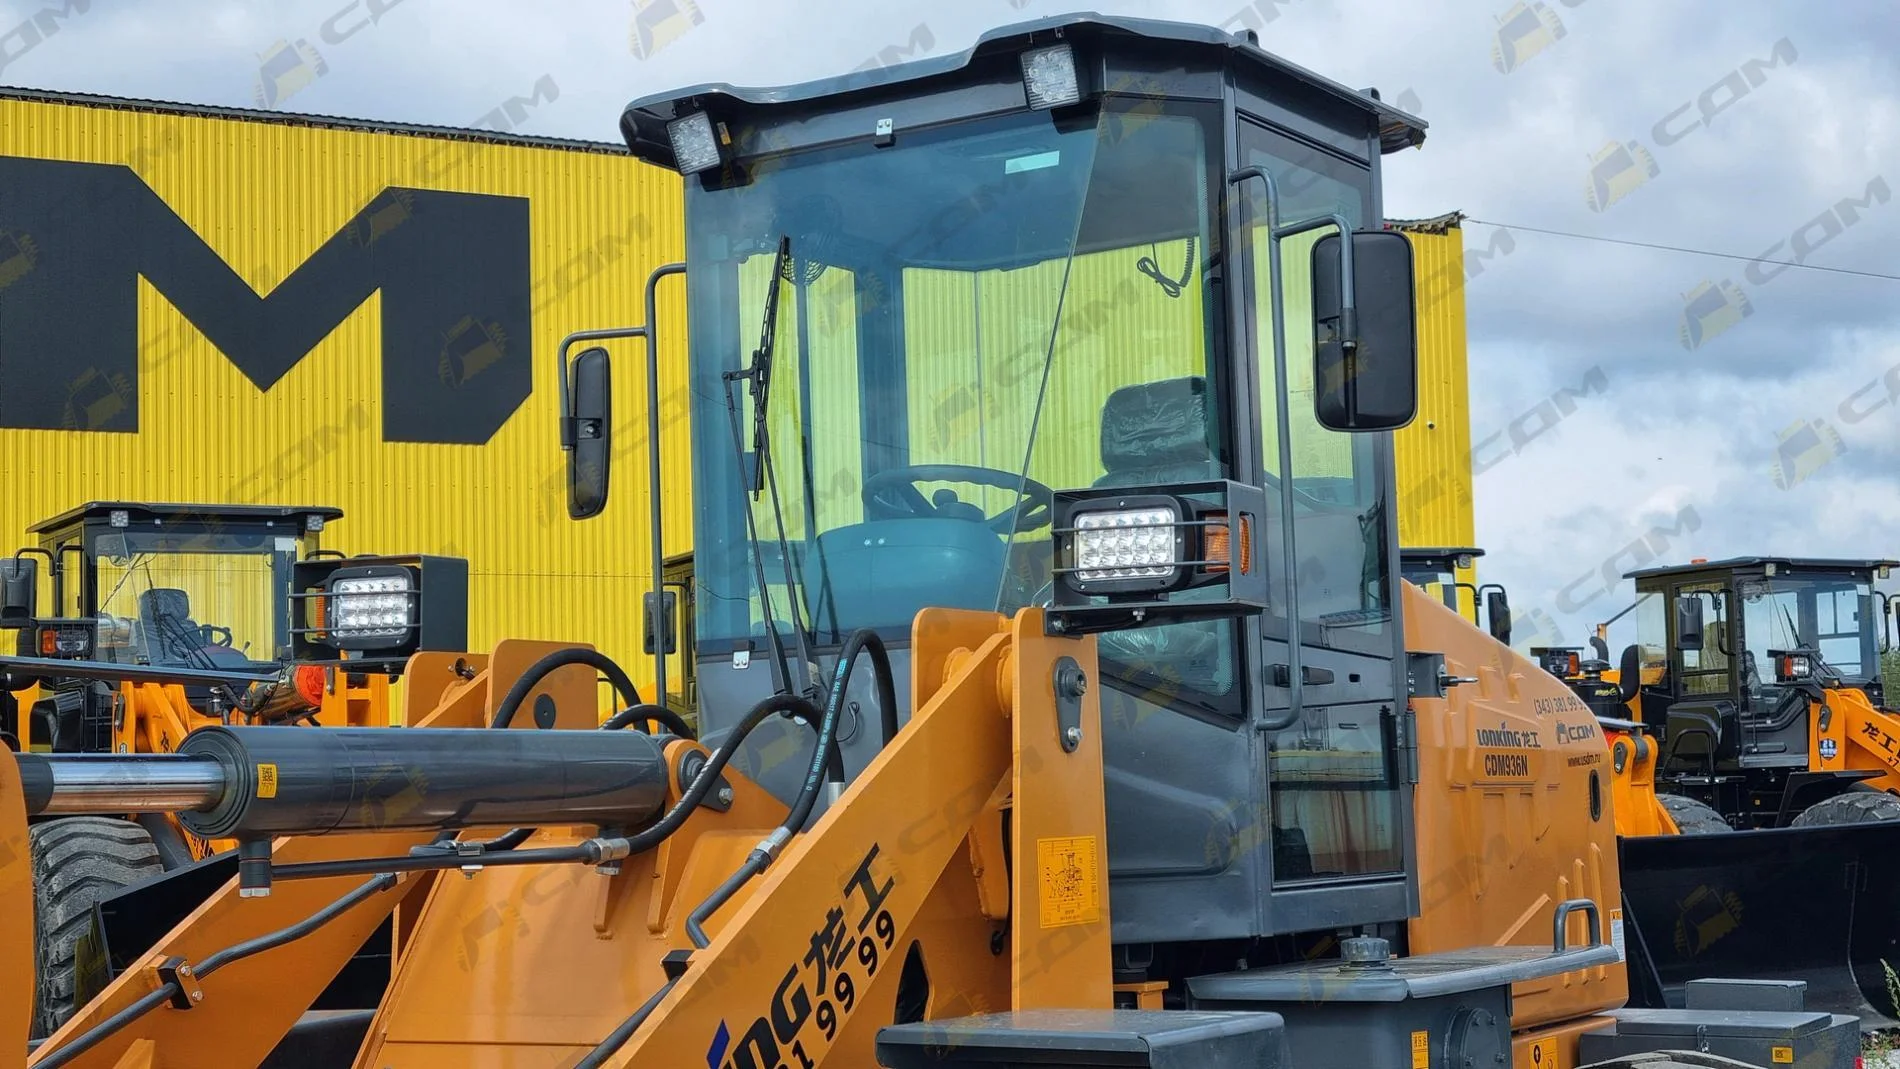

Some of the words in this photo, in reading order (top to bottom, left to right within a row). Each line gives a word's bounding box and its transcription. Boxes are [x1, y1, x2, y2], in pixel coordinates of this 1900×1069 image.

[1533, 697, 1553, 716] (343)
[1554, 696, 1569, 713] 381
[1484, 754, 1529, 777] CDM936N
[815, 971, 856, 1043] 99
[857, 909, 896, 978] 99
